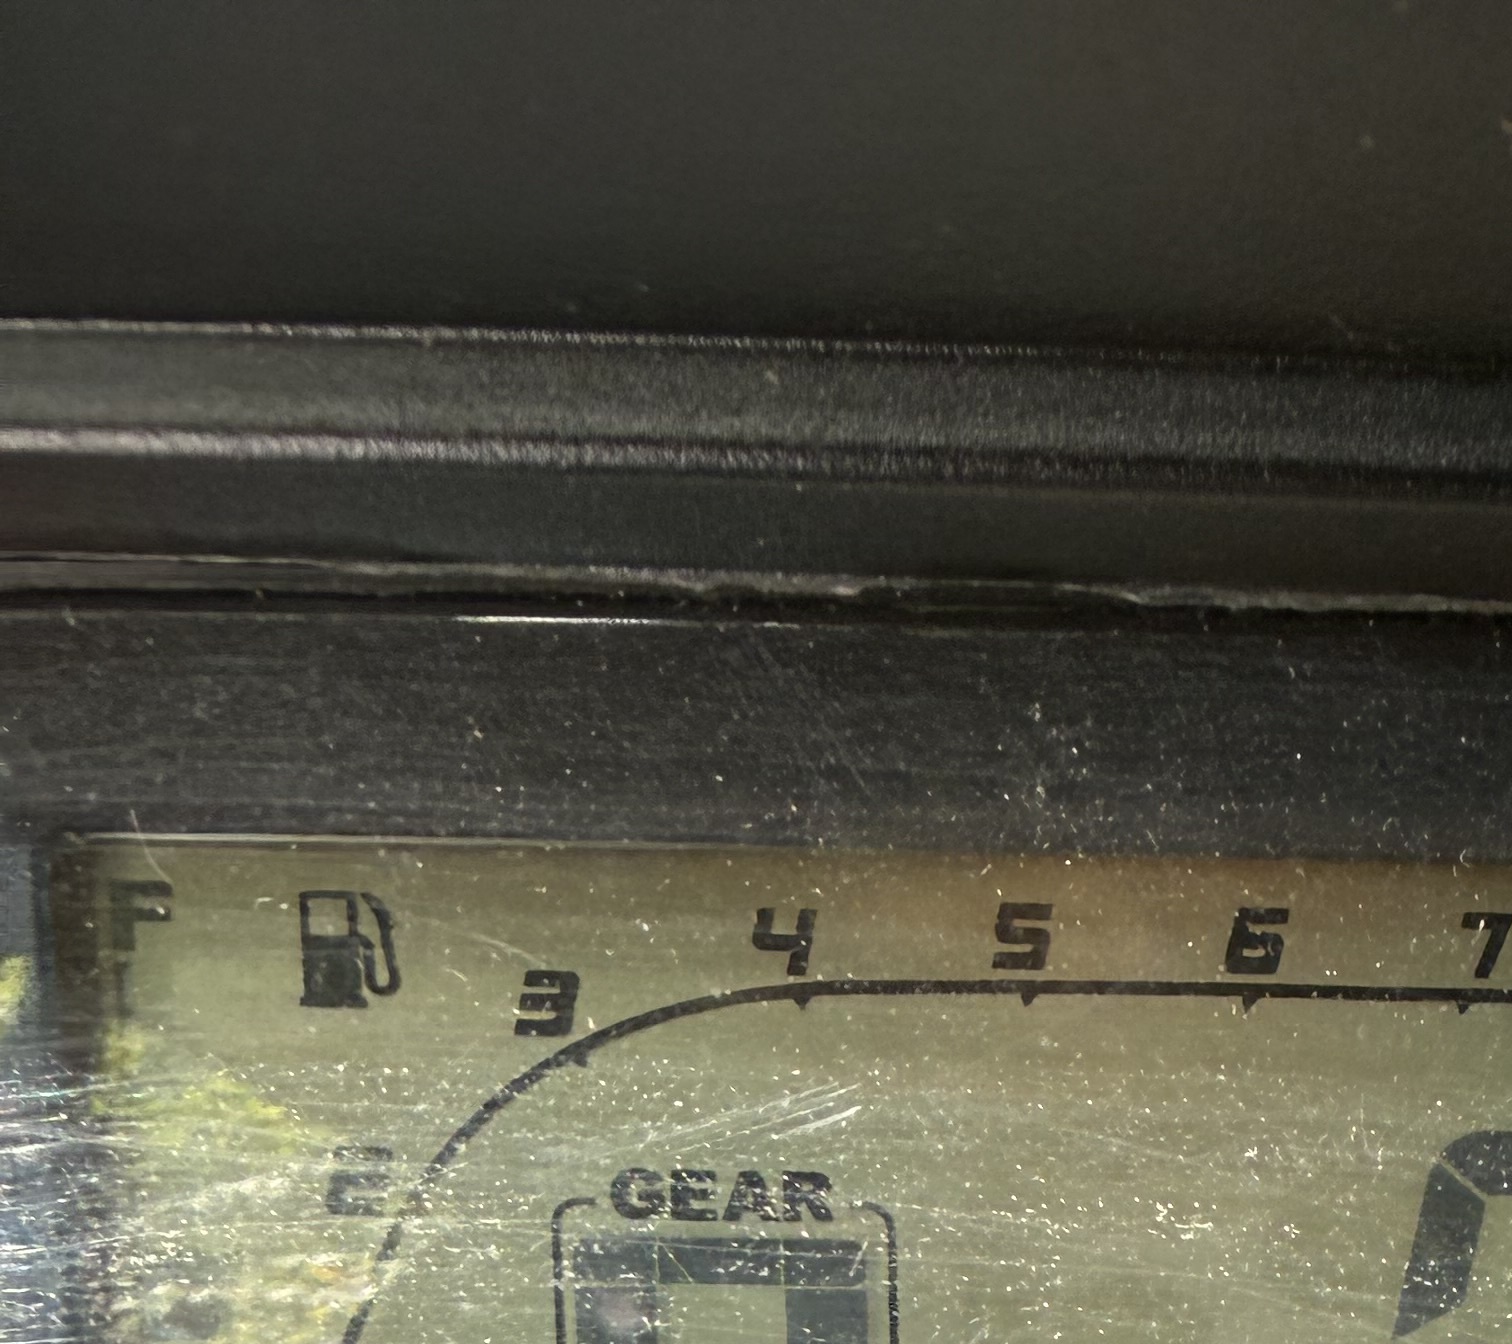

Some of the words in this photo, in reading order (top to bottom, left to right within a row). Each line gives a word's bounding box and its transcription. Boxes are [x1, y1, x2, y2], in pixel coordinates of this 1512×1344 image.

[514, 968, 580, 1037] 3
[752, 907, 818, 977] 4
[991, 902, 1054, 971] 5
[1225, 906, 1290, 976] 6
[608, 1167, 836, 1223] GEAR
